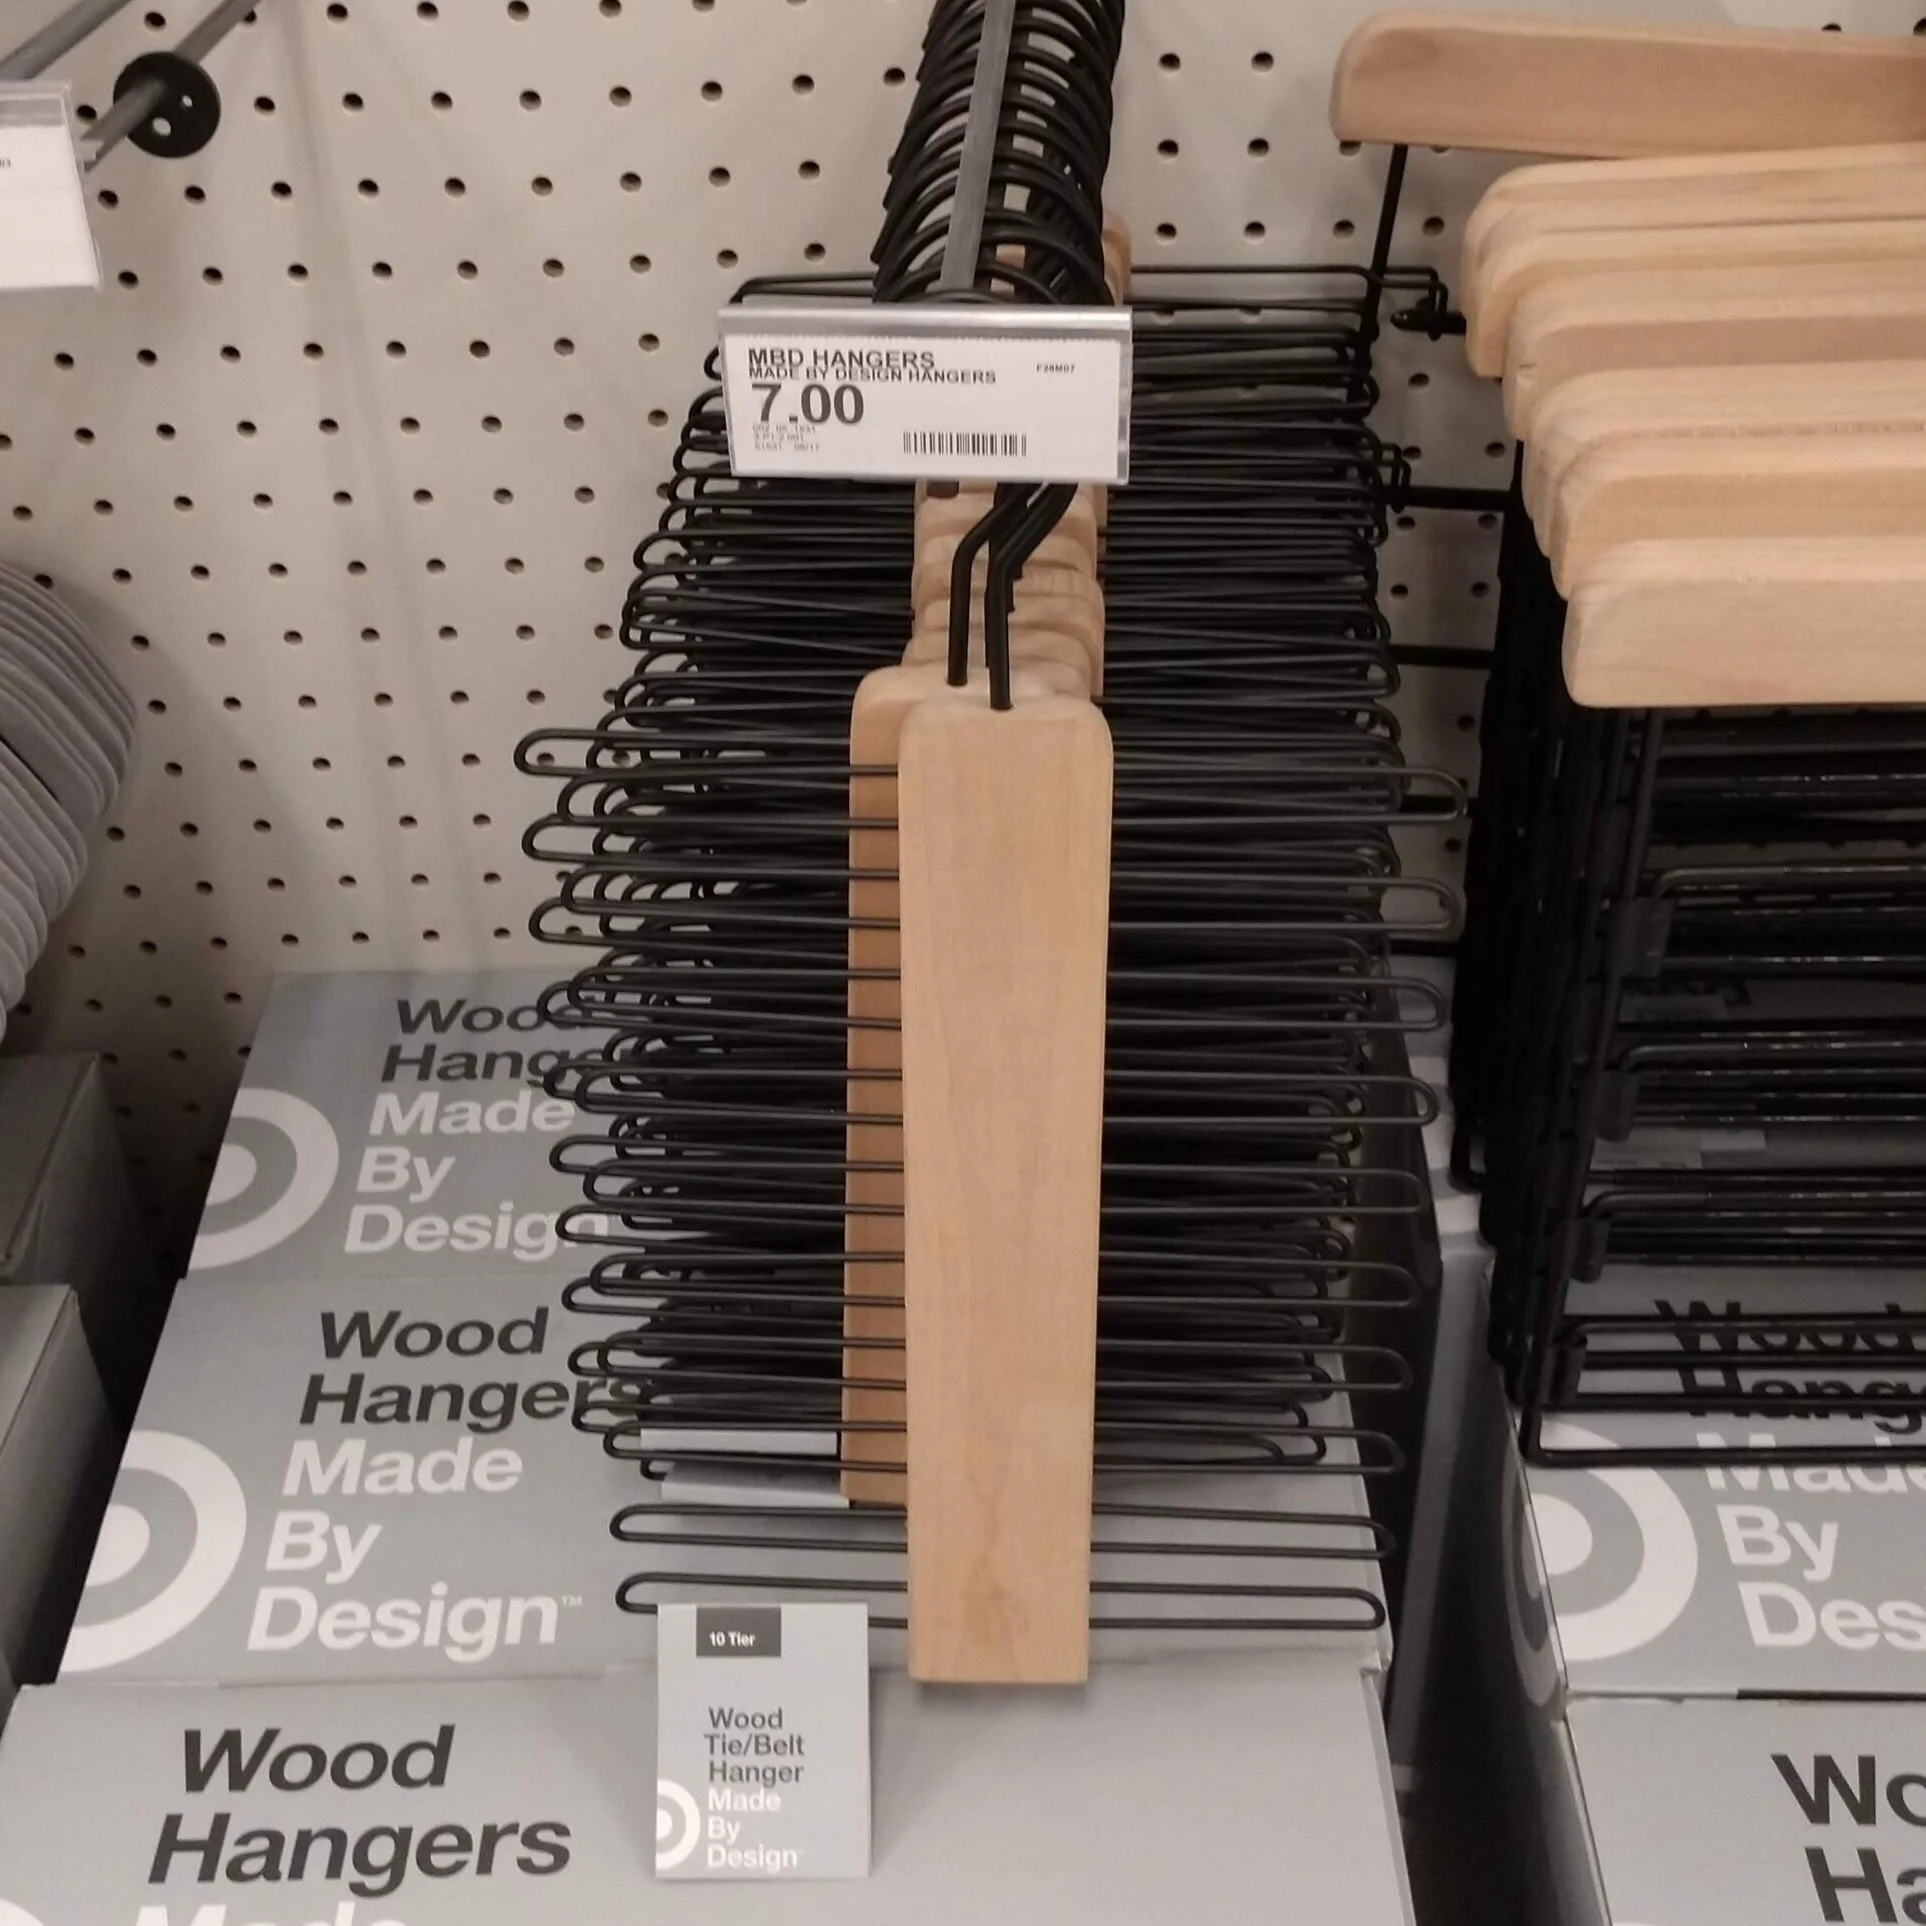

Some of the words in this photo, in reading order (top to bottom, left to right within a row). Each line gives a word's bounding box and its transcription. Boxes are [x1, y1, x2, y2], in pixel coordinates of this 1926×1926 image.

[748, 347, 804, 367] MBD
[812, 349, 936, 369] HANGERS
[748, 366, 800, 381] MADE
[805, 367, 829, 381] BY
[835, 367, 902, 383] DESIGN
[908, 369, 997, 385] HANGERS
[751, 382, 865, 425] 7.00
[368, 1089, 575, 1136] Made
[355, 1146, 456, 1202] By
[319, 1306, 550, 1360] Wood
[282, 1436, 524, 1496] Made
[265, 1509, 383, 1585] By
[1716, 1504, 1840, 1582] By
[709, 1631, 726, 1647] 10
[728, 1631, 756, 1648] Tier
[708, 1706, 784, 1730] Wood
[183, 1724, 456, 1793] Wood
[704, 1733, 805, 1756] Tie/Belt
[708, 1760, 805, 1789] Hanger
[708, 1788, 782, 1812] Made
[707, 1816, 741, 1844] By
[148, 1813, 572, 1898] Hangers
[707, 1843, 798, 1873] Design
